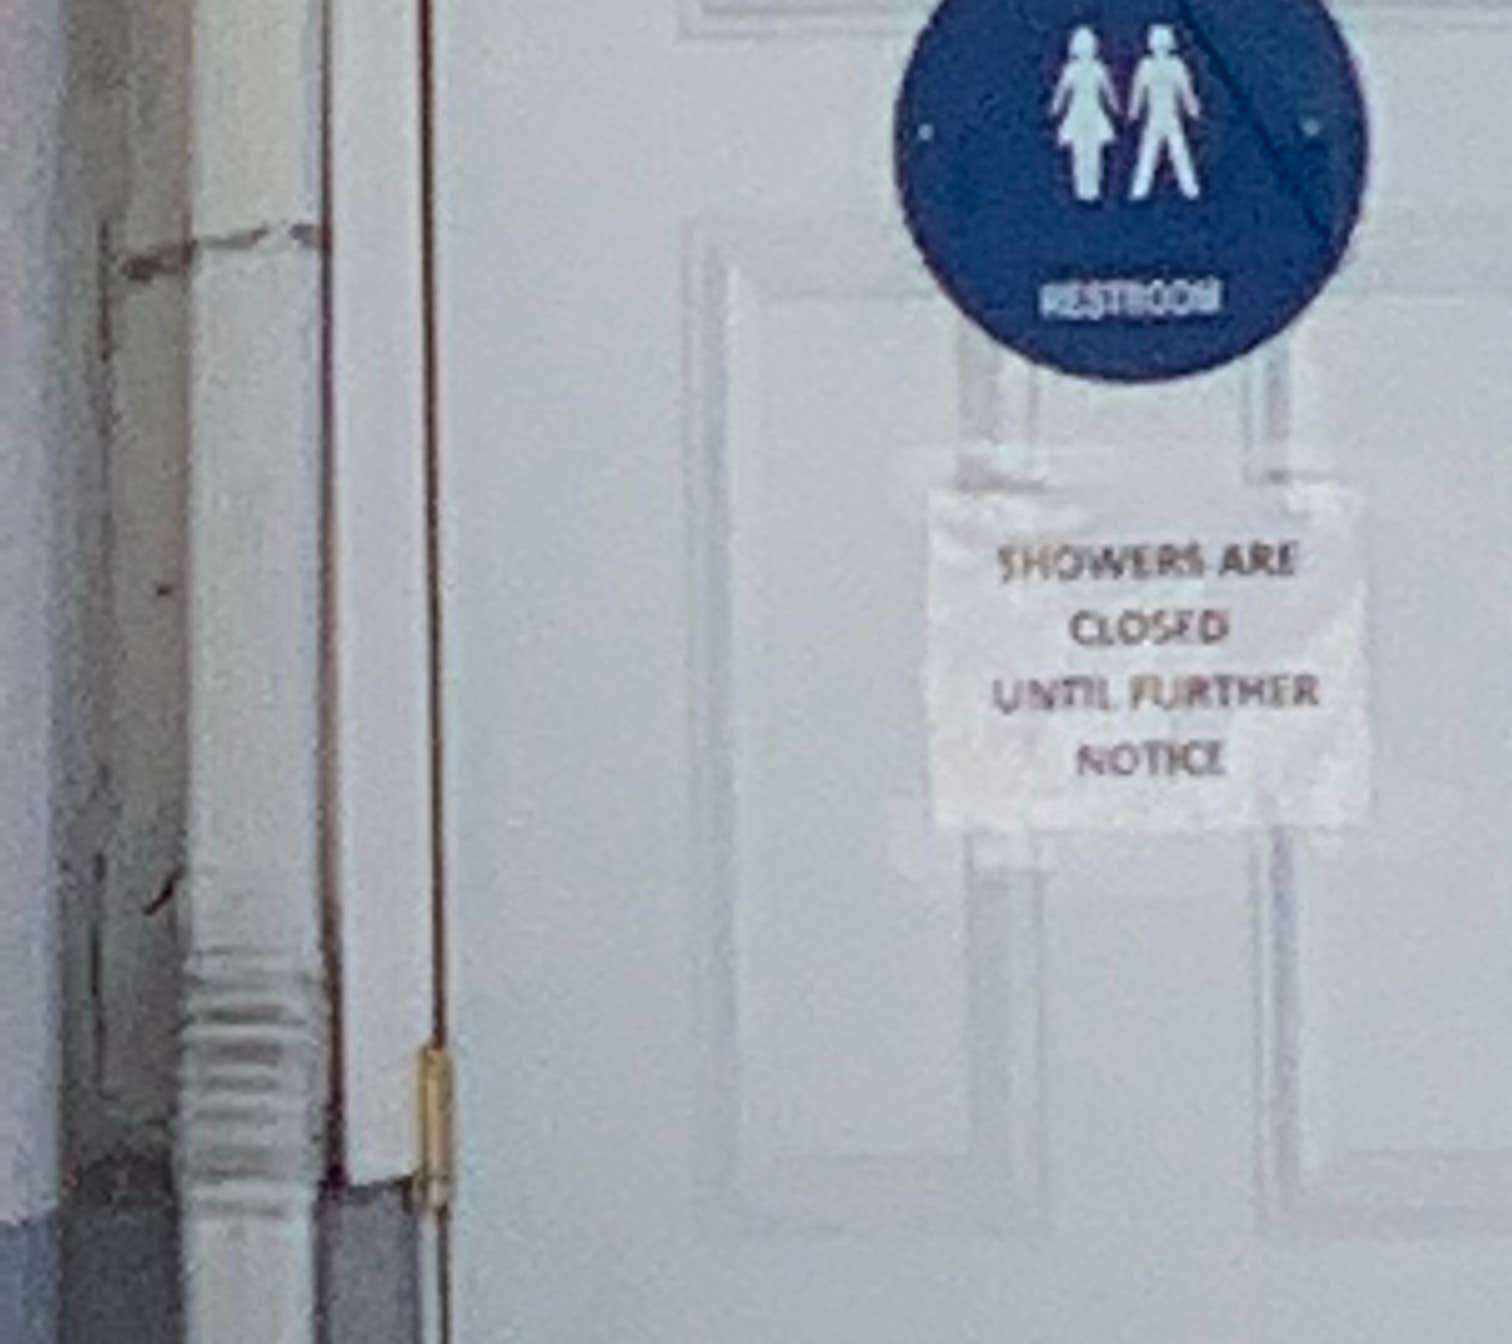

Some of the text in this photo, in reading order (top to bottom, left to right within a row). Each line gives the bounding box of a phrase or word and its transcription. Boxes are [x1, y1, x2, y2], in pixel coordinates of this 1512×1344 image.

[1039, 278, 1225, 318] RESTROOM
[998, 540, 1299, 584] SHOWERS ARE
[1069, 609, 1231, 647] CLOSED
[992, 674, 1321, 714] UNTIL FURTHER
[1076, 740, 1227, 776] NOTICE
